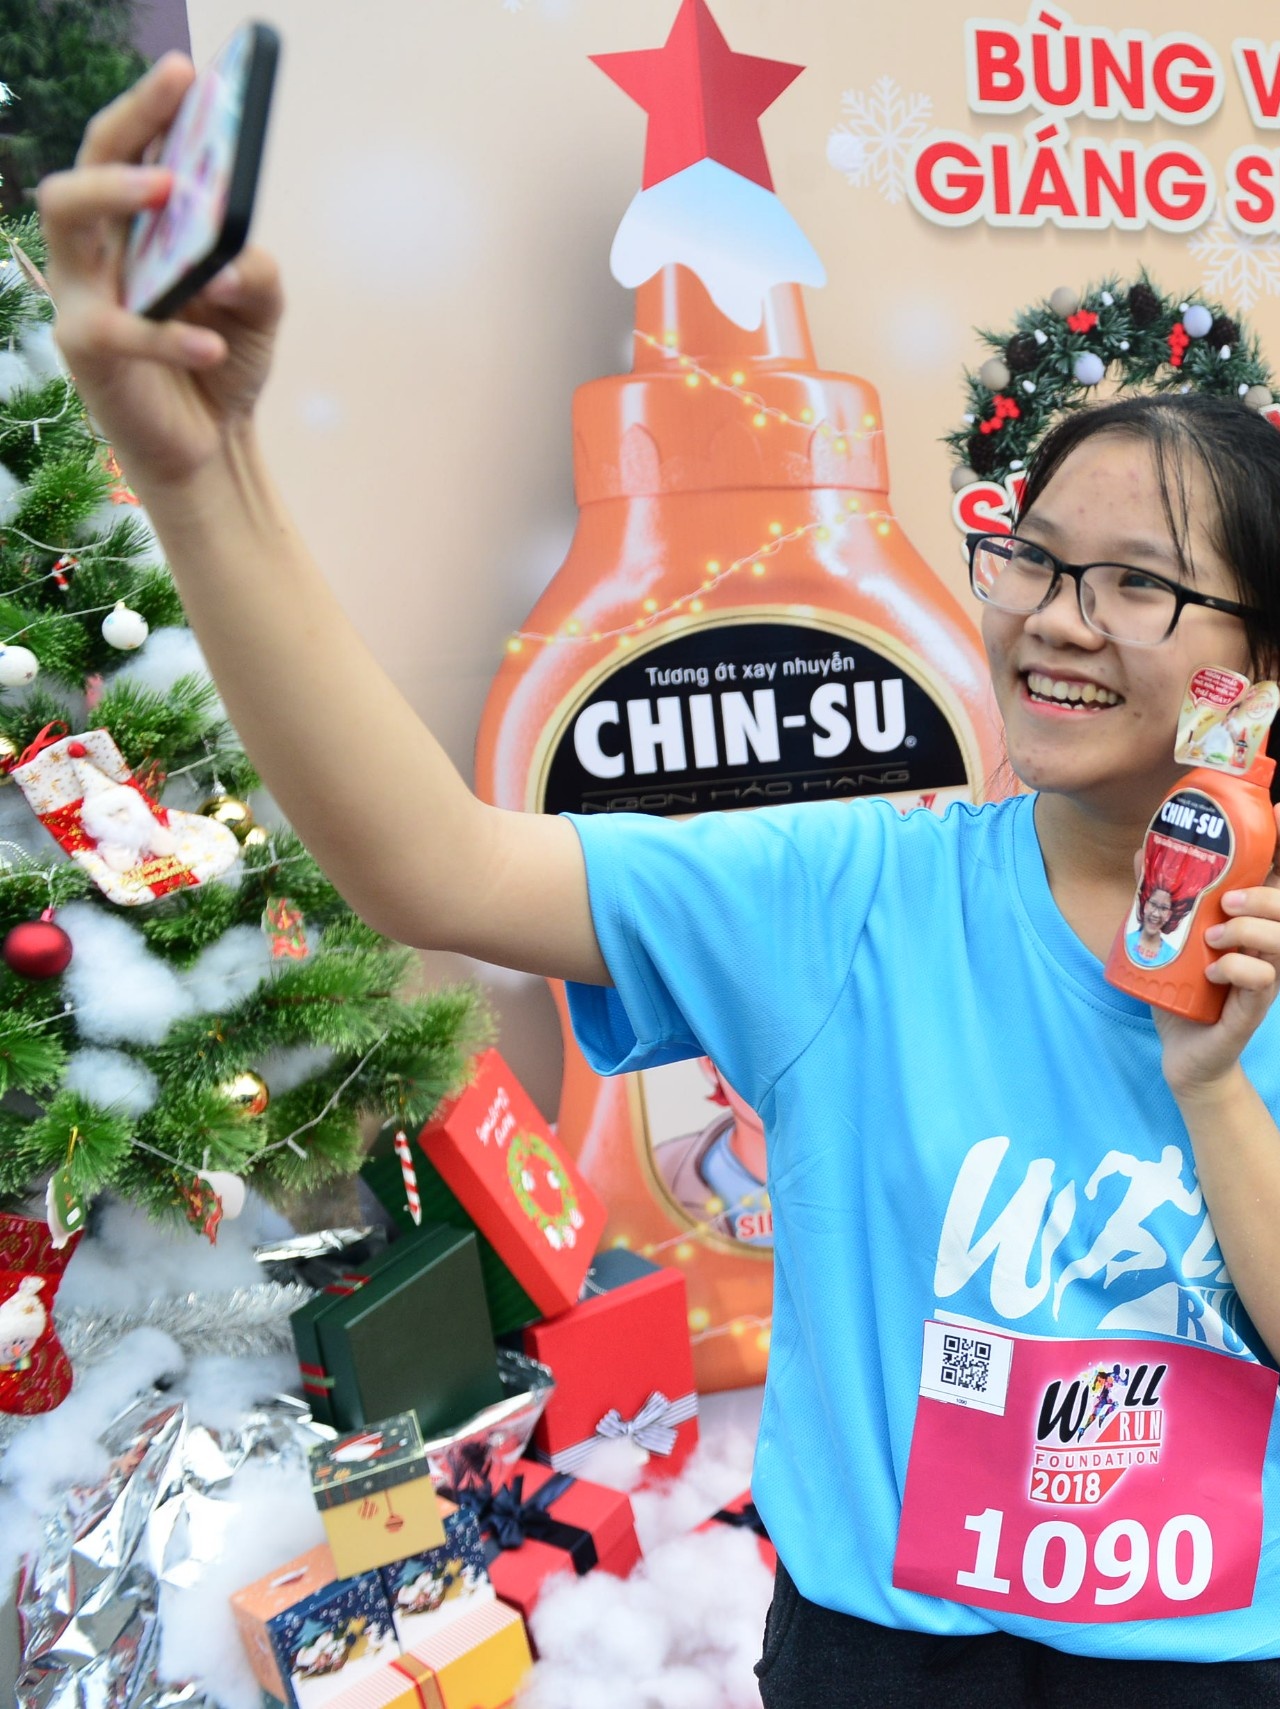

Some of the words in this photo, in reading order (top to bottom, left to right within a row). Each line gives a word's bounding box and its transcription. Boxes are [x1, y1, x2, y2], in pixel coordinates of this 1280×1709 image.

[976, 12, 1214, 114] BÙNG
[915, 125, 1206, 221] GIÁNG
[645, 665, 710, 687] Tương
[715, 662, 737, 682] ớt
[742, 661, 777, 682] xay
[783, 651, 856, 677] nhuyễn
[573, 678, 907, 778] CHIN-SU
[1161, 802, 1225, 839] CHIN-SU
[1119, 1410, 1161, 1441] RUN
[1035, 1450, 1159, 1469] FOUNDATION
[1031, 1470, 1101, 1503] 2018
[957, 1508, 1214, 1606] 1090
